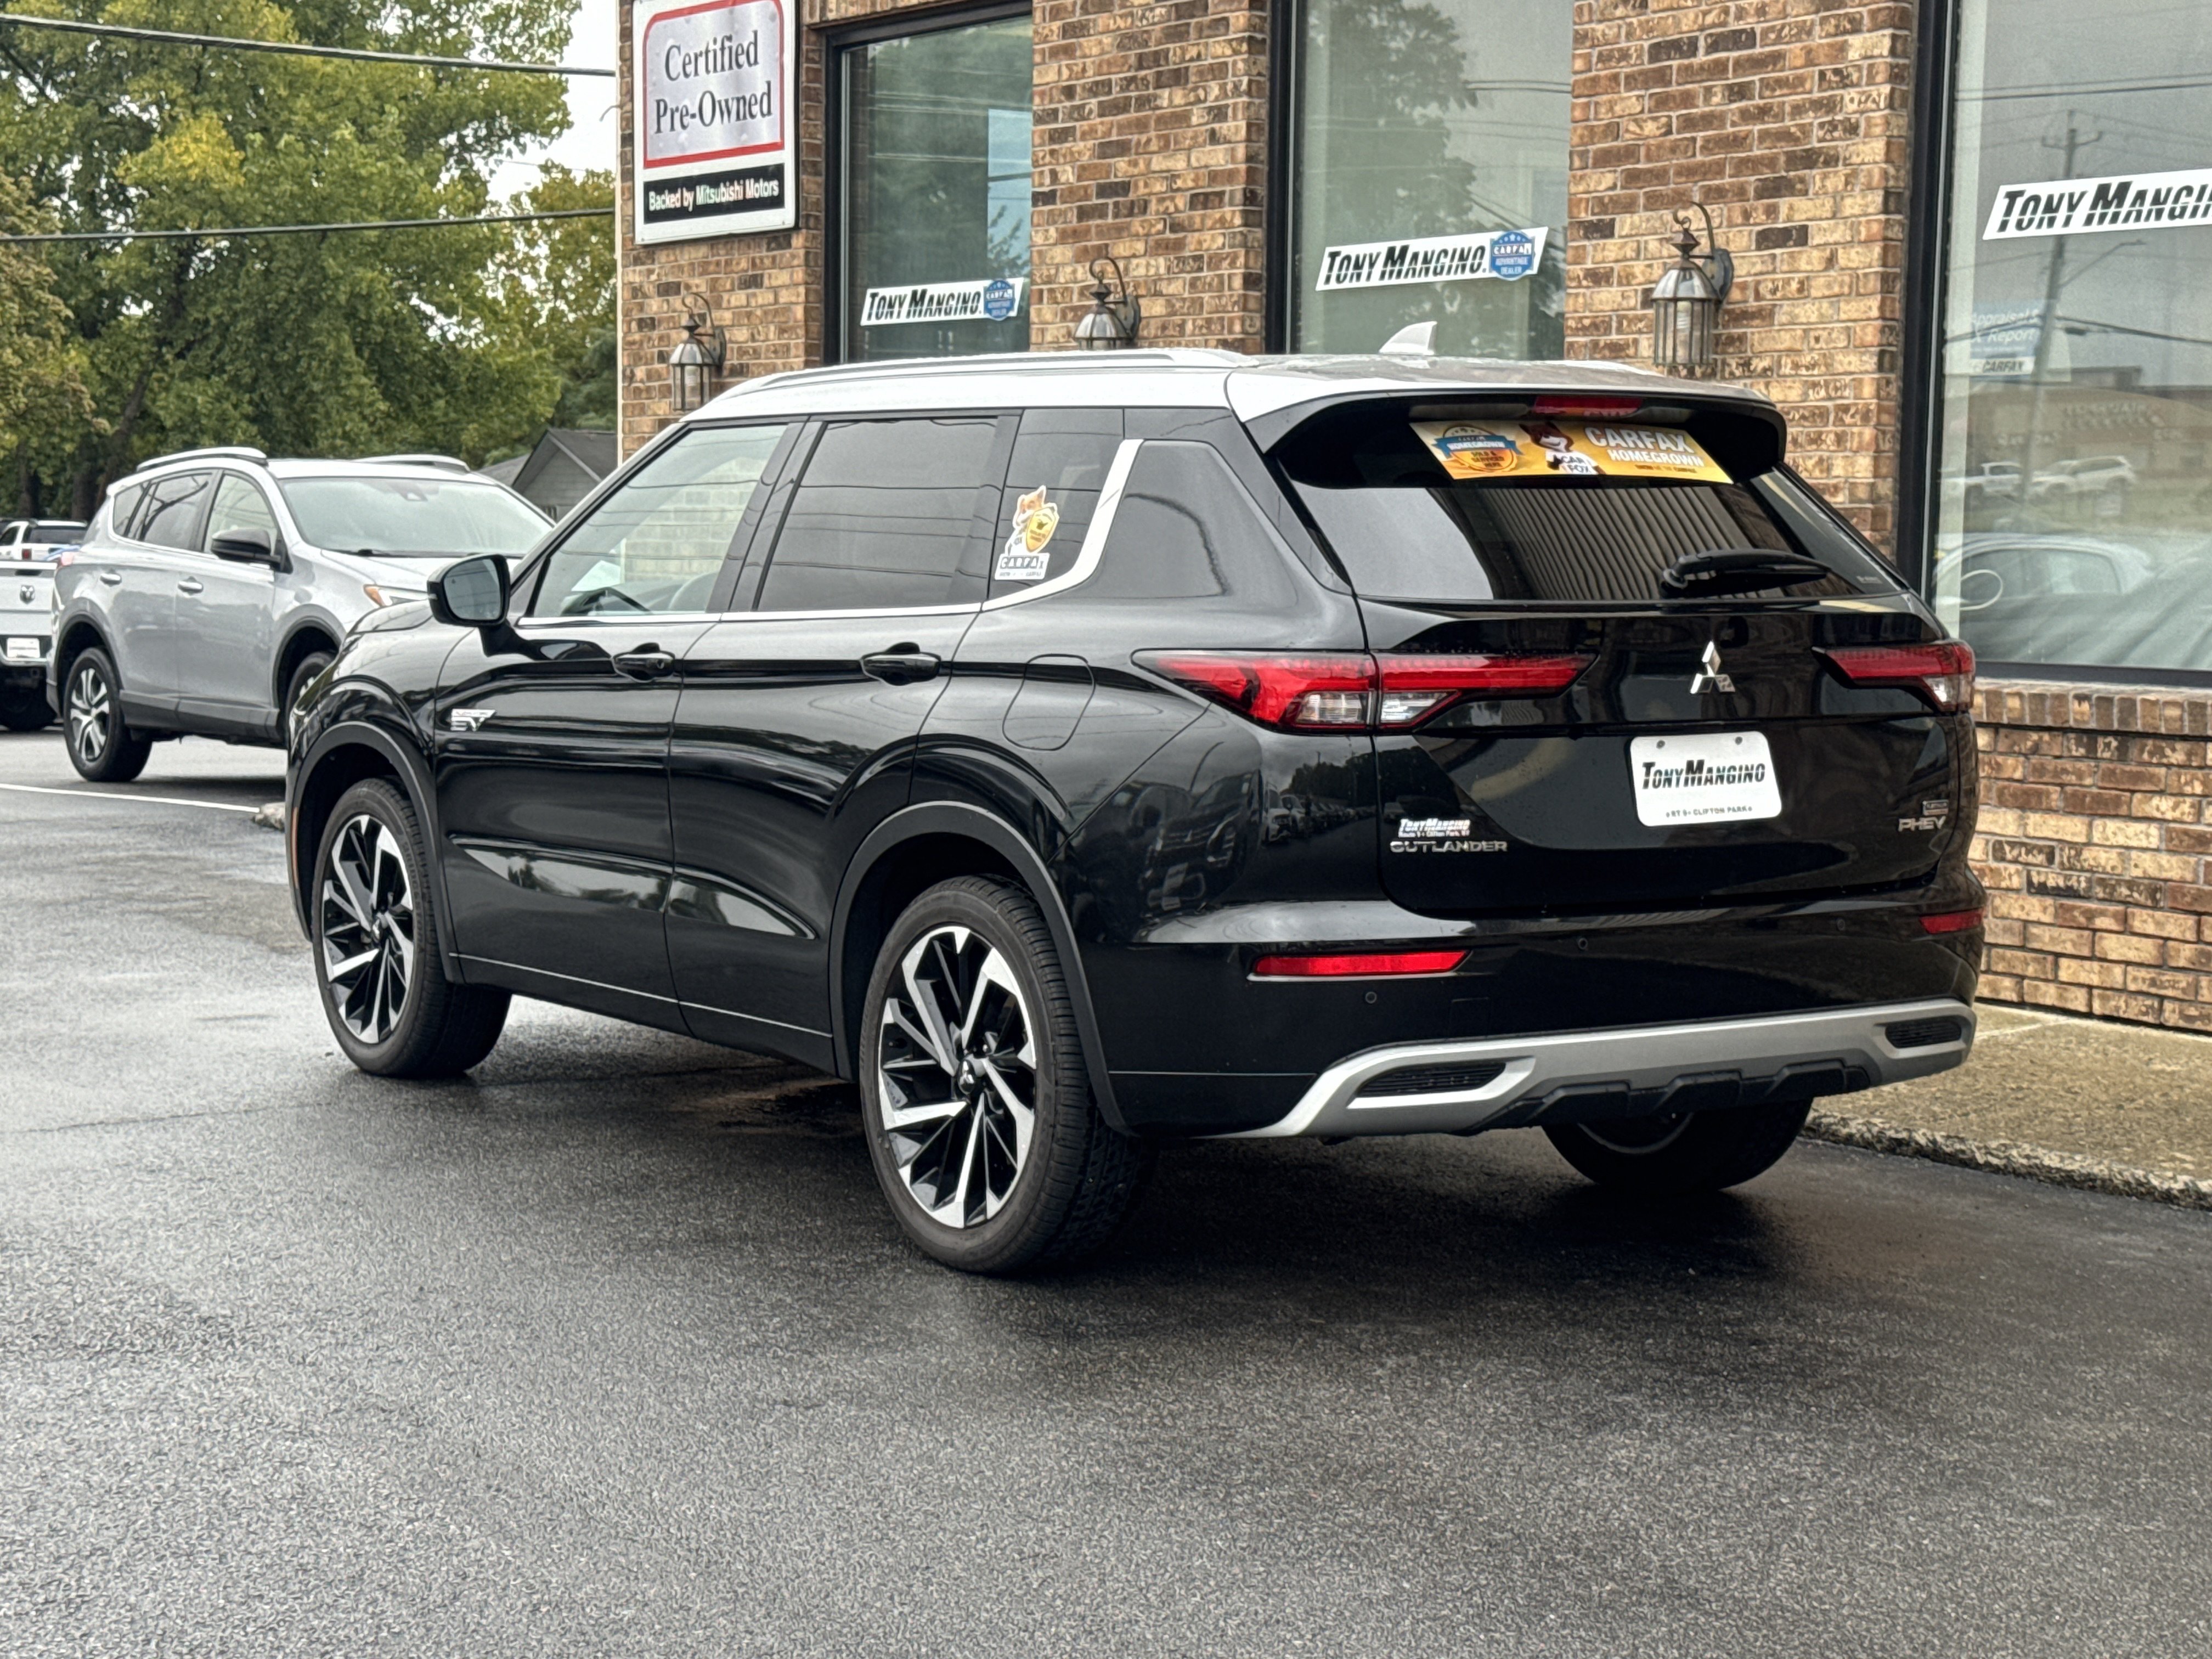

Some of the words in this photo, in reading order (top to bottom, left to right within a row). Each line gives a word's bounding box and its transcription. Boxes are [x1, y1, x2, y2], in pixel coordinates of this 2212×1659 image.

[664, 30, 759, 81] Certified
[654, 80, 773, 134] Pre-Owned
[648, 189, 681, 211] Backed
[682, 187, 695, 212] by
[696, 180, 744, 206] Mitsubishi
[745, 178, 779, 200] Motors
[1996, 189, 2089, 234] TONY
[1323, 250, 1382, 286] TONY
[866, 292, 907, 321] TONY
[1585, 427, 1695, 453] CARFAX
[1607, 449, 1705, 467] HOMEGROWN
[1390, 840, 1508, 853] OUTLANDER
